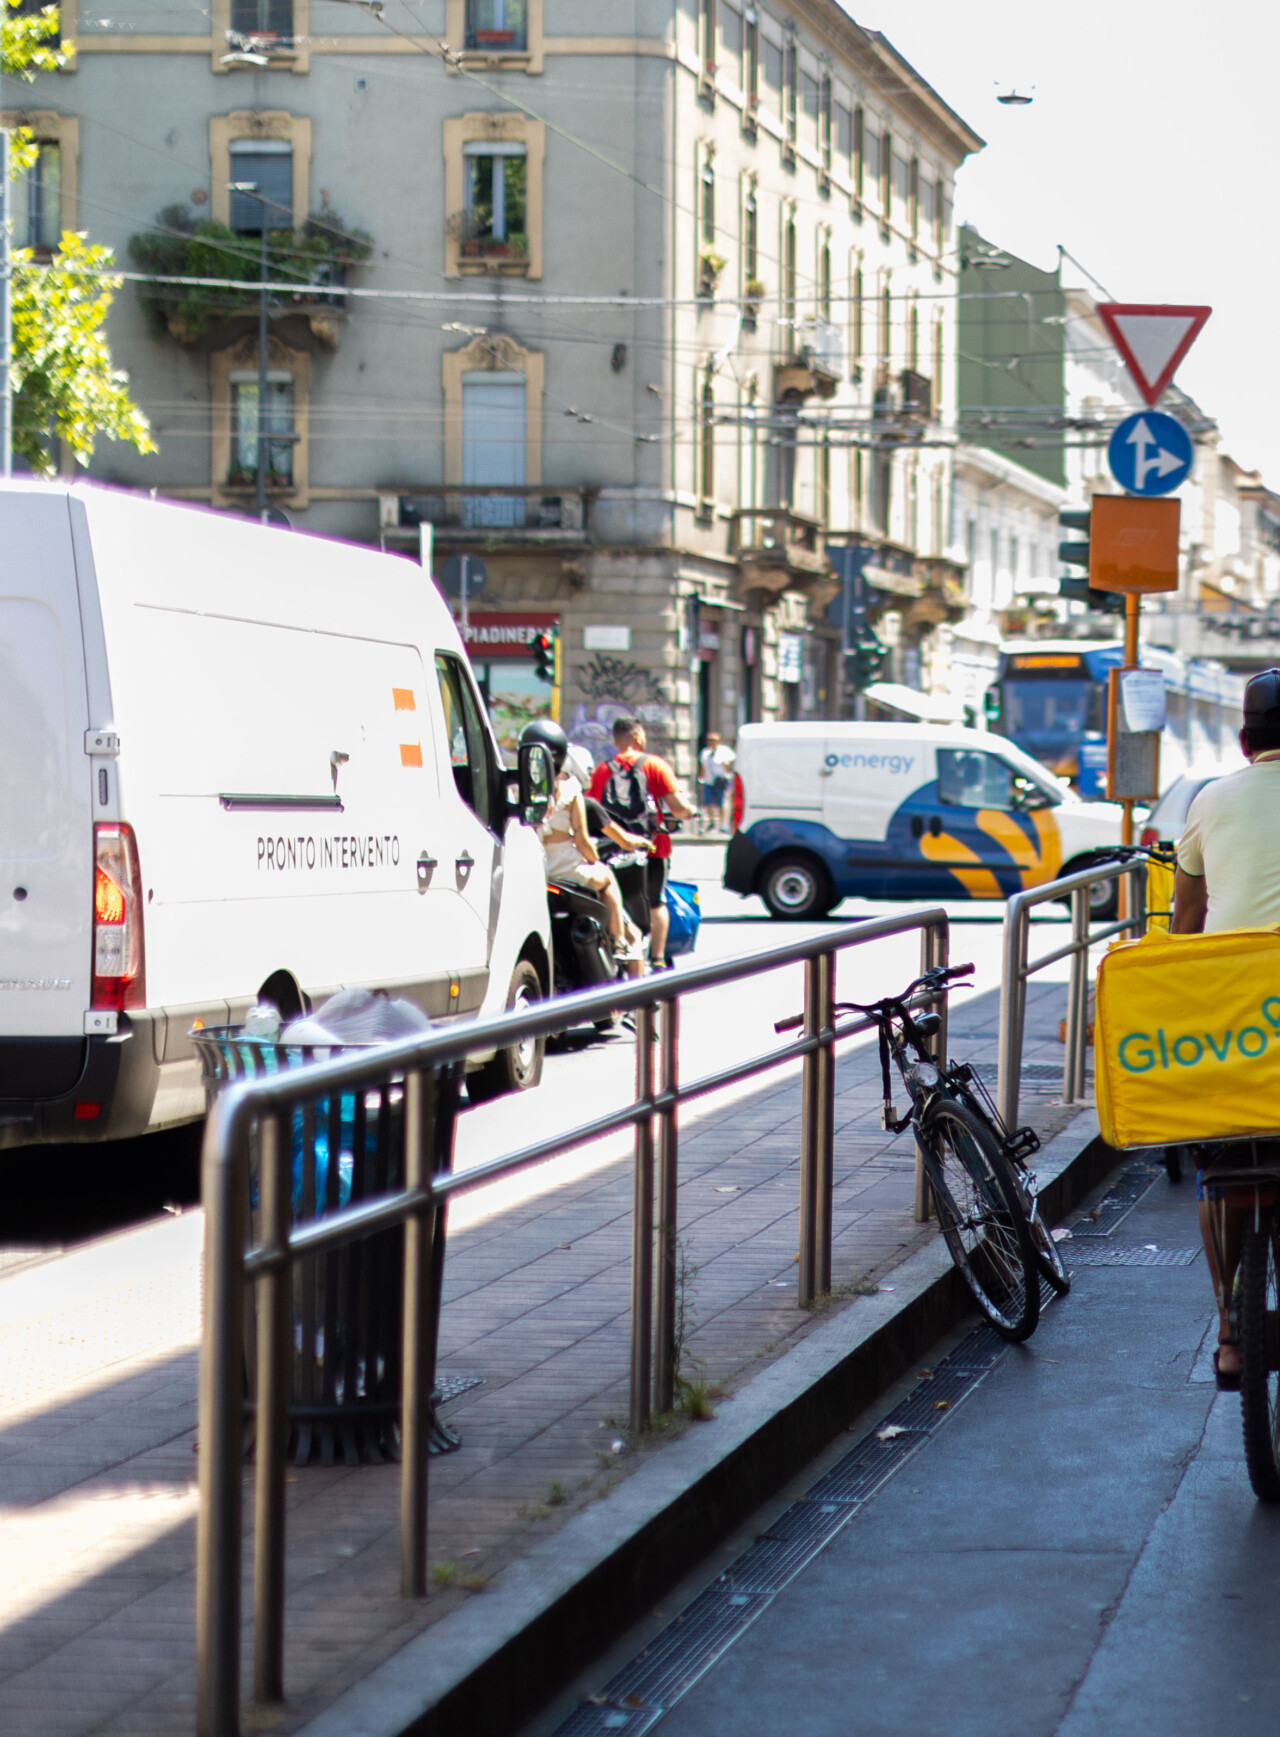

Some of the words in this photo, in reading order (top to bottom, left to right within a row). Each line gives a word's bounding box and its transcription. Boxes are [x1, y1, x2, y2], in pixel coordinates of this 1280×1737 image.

[257, 836, 316, 871] PRONTO
[320, 835, 400, 869] INTERVENTO
[1117, 1026, 1268, 1074] Glovo
